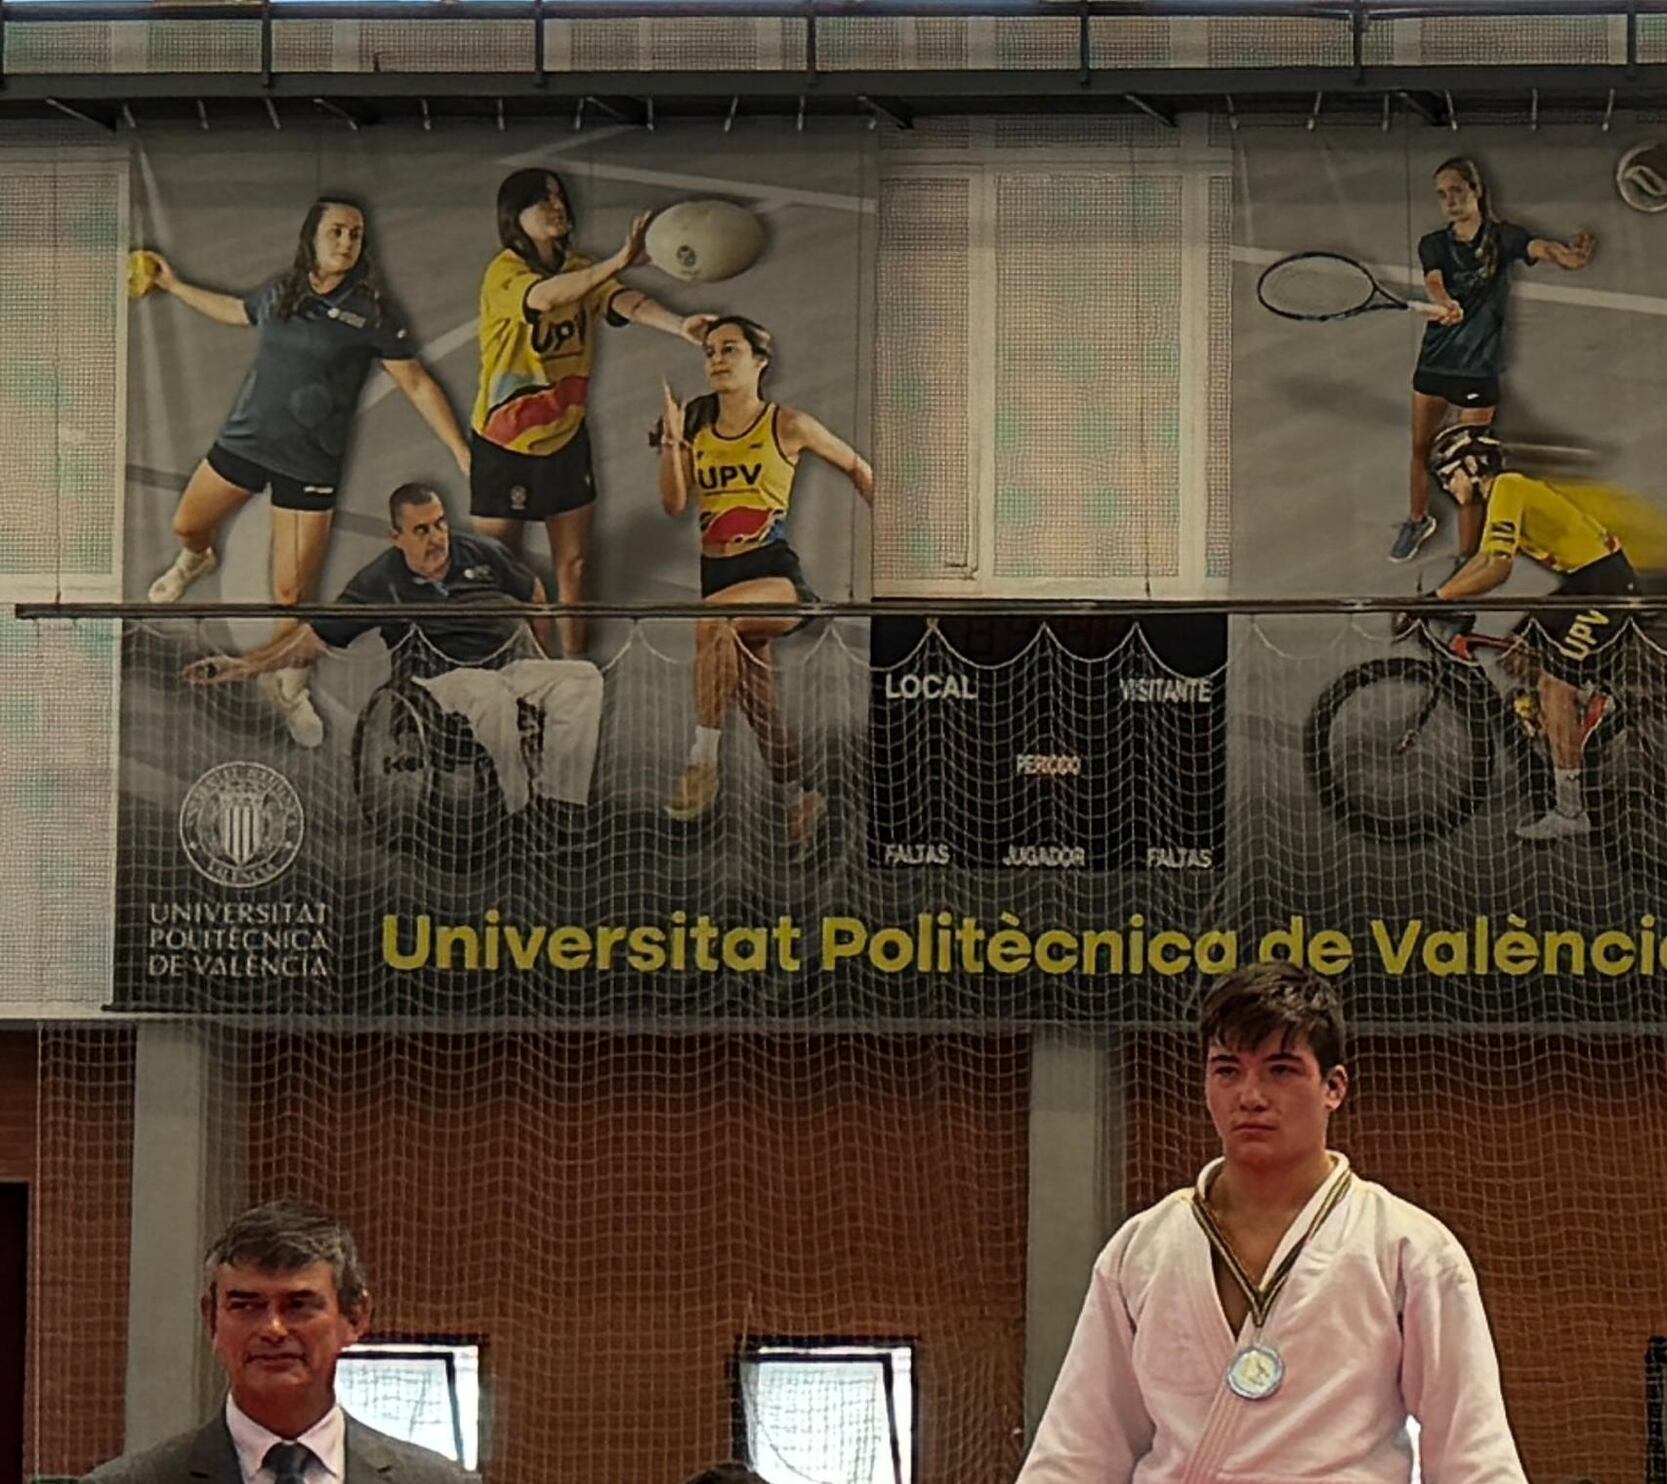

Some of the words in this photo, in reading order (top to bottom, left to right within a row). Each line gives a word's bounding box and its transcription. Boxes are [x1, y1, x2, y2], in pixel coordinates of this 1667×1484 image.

[700, 463, 762, 490] UPV
[1560, 609, 1609, 662] UPV
[885, 674, 979, 700] LOCAL
[1119, 677, 1214, 703] VISITANTE
[884, 844, 950, 866] FALTAS
[1002, 845, 1086, 868] JUGADOR
[1148, 847, 1213, 869] FALTAS
[151, 902, 327, 924] UNIVERSITAT
[382, 909, 800, 971] Universitat
[822, 911, 1237, 975] Politècnica
[1259, 914, 1353, 975] de
[150, 954, 182, 977] DE
